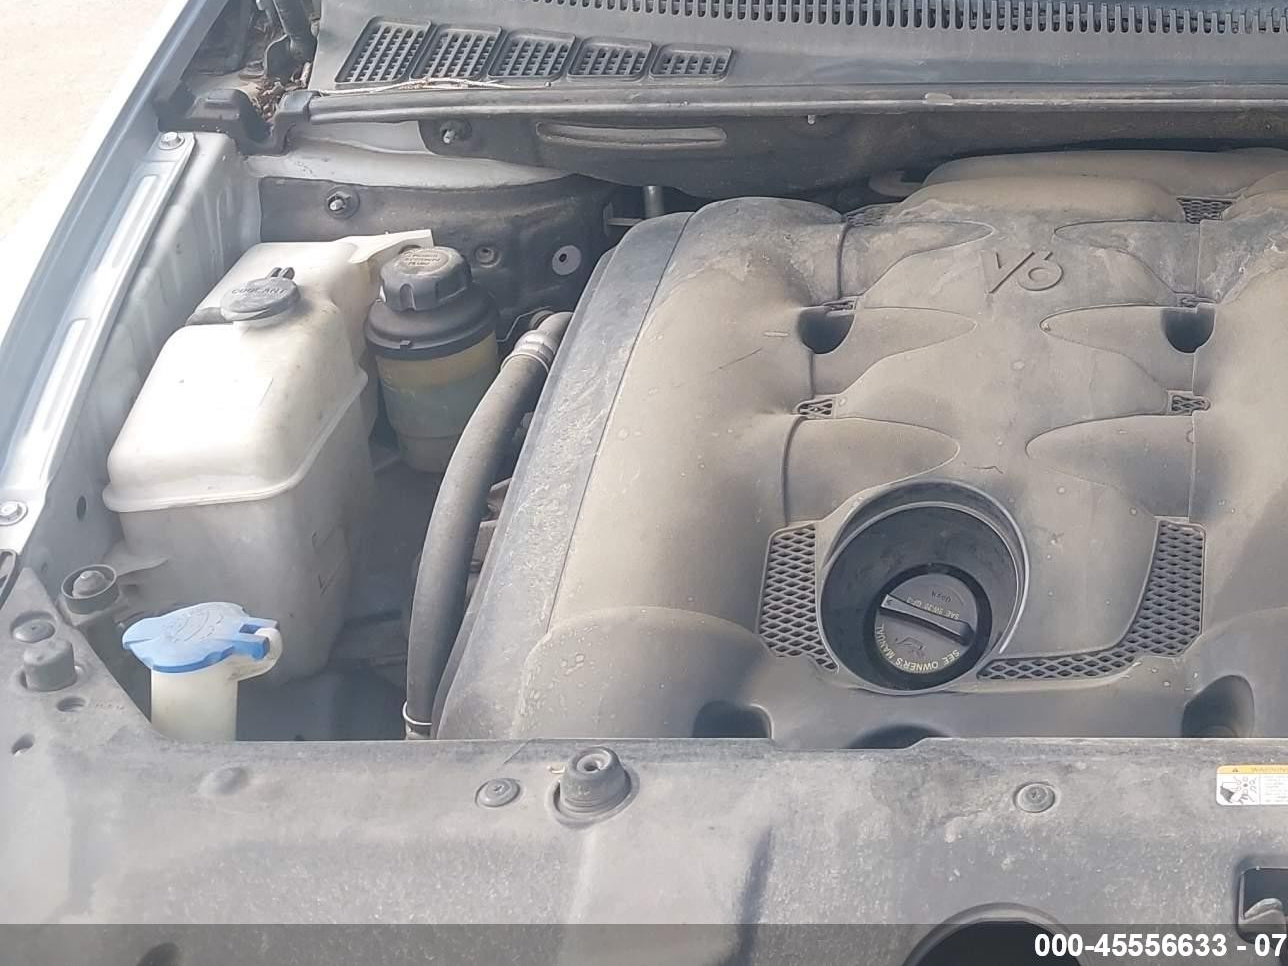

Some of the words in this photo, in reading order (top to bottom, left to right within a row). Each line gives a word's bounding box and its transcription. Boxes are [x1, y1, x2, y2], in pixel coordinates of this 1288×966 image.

[980, 249, 1064, 294] V6
[876, 623, 896, 659] MANUAL
[895, 657, 939, 671] OWNER'S
[942, 649, 960, 665] SEE
